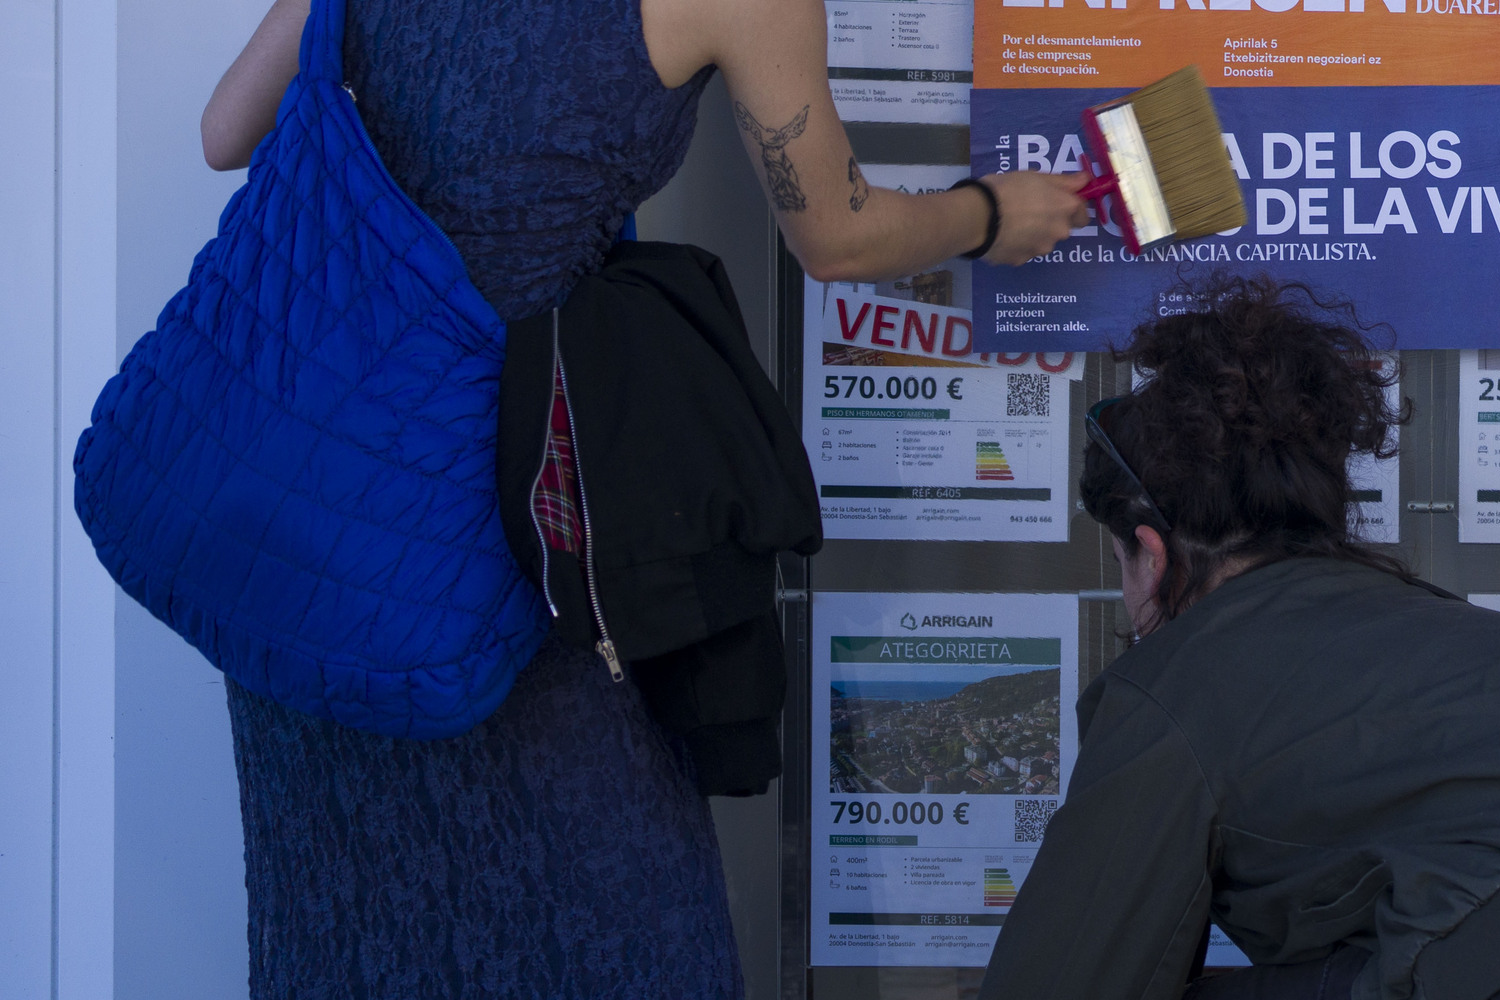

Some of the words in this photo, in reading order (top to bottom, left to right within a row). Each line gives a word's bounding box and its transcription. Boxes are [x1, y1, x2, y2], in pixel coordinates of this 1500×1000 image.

[1004, 35, 1022, 44] Por
[1025, 35, 1034, 44] el
[1037, 35, 1141, 46] desmantelamiento
[1003, 49, 1016, 58] de
[1019, 49, 1034, 58] las
[1037, 52, 1091, 61] empresas
[906, 70, 928, 81] REF.
[930, 70, 957, 82] 5981
[1003, 63, 1016, 73] de
[1019, 63, 1099, 76] desocupación.
[1263, 132, 1335, 179] DE
[1350, 130, 1461, 179] LOS
[1256, 188, 1328, 235] DE
[1344, 188, 1418, 234] LA
[1236, 243, 1376, 260] CAPITALISTA.
[825, 376, 936, 399] 570.000
[947, 378, 963, 400] €
[921, 616, 992, 627] ARRIGAIN
[880, 643, 1011, 661] ATEGORRIETA
[830, 801, 943, 824] 790.000
[953, 802, 969, 824] €
[920, 915, 941, 926] REF.
[943, 915, 969, 926] 5814
